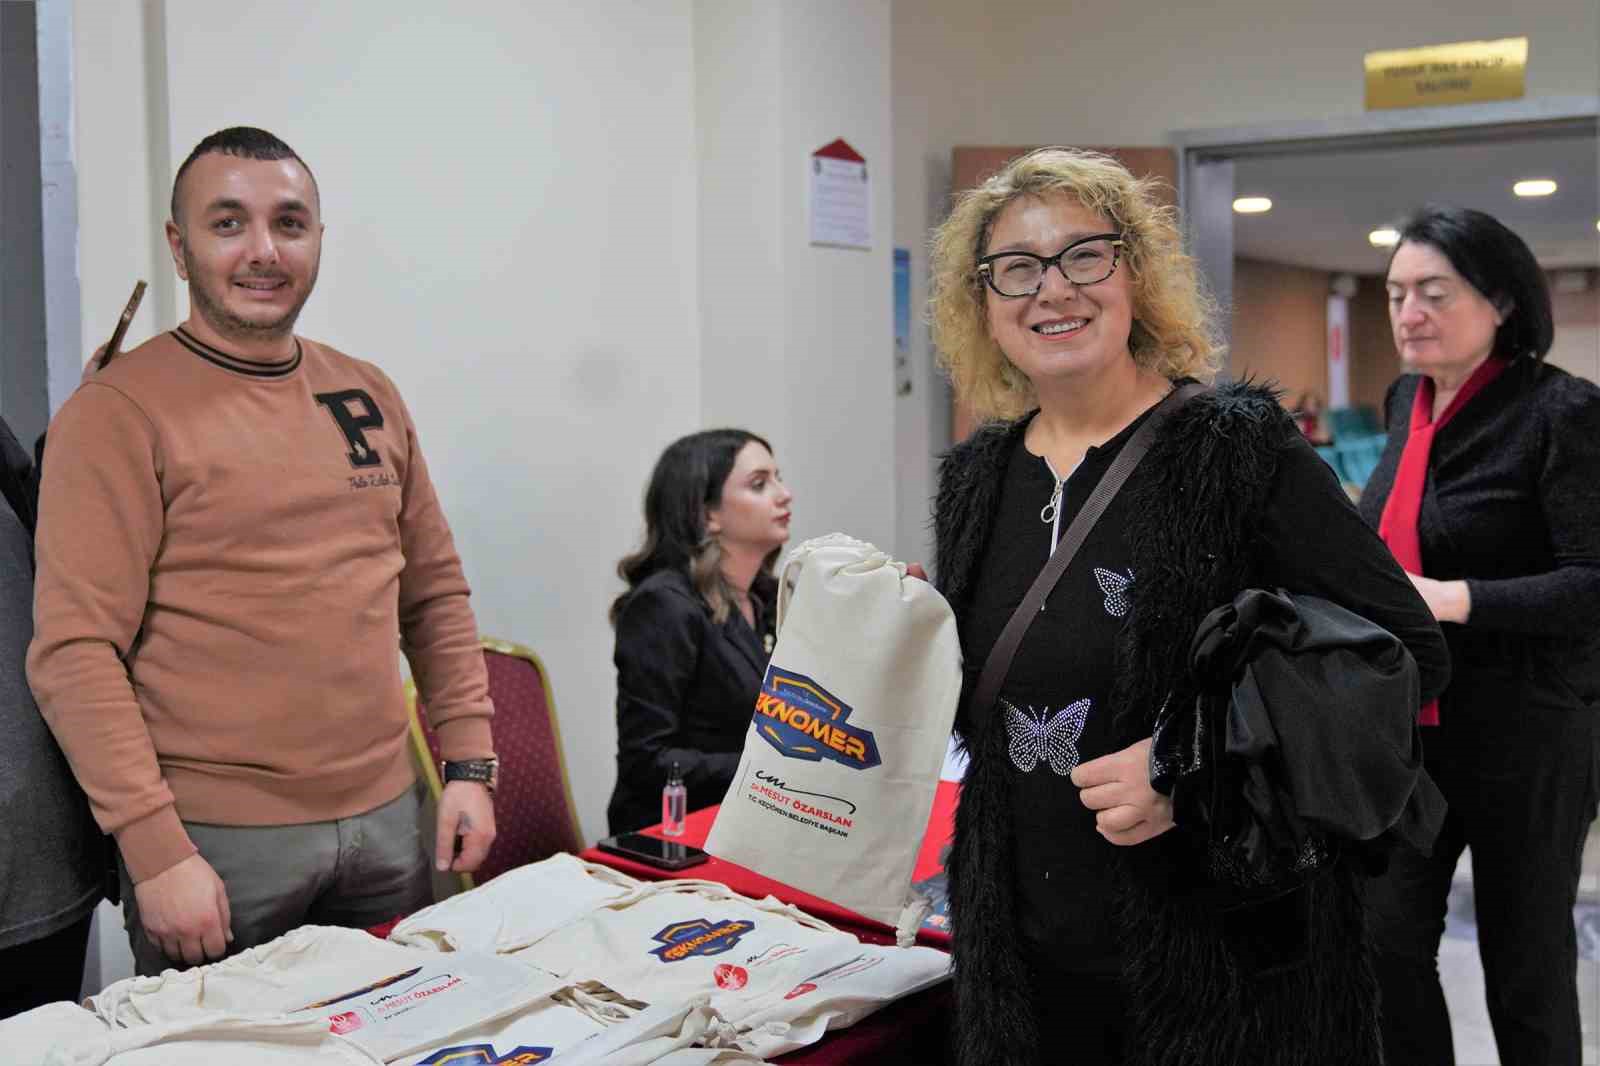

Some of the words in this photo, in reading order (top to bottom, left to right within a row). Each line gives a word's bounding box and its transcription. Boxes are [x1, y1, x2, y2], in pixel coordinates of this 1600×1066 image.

[313, 388, 384, 469] P
[760, 785, 791, 806] MESUT
[792, 799, 853, 829] ÖZARSLAN
